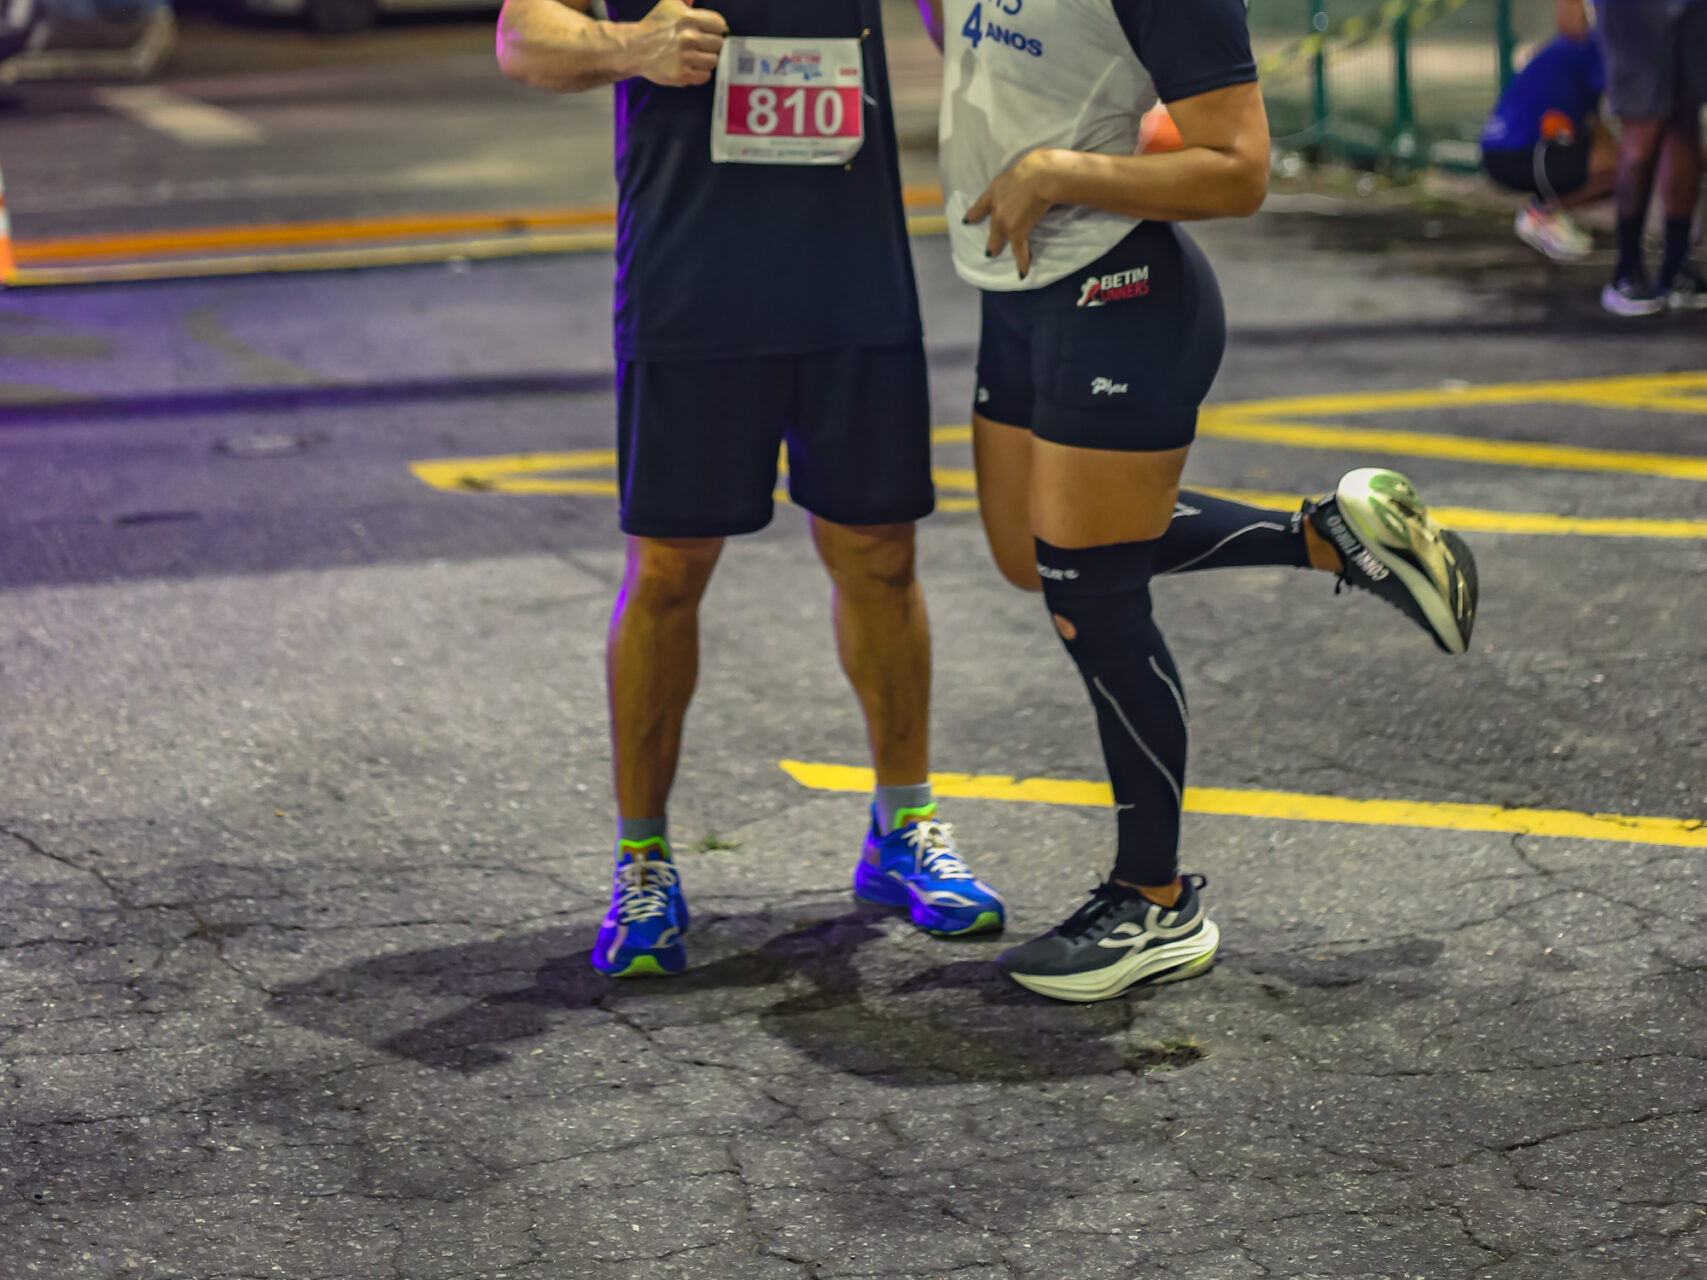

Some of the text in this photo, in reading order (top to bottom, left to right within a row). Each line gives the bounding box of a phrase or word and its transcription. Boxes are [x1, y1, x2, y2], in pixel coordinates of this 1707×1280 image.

[961, 1, 1043, 58] 4 ANOS
[745, 87, 845, 136] 810
[1100, 264, 1149, 291] BETIM
